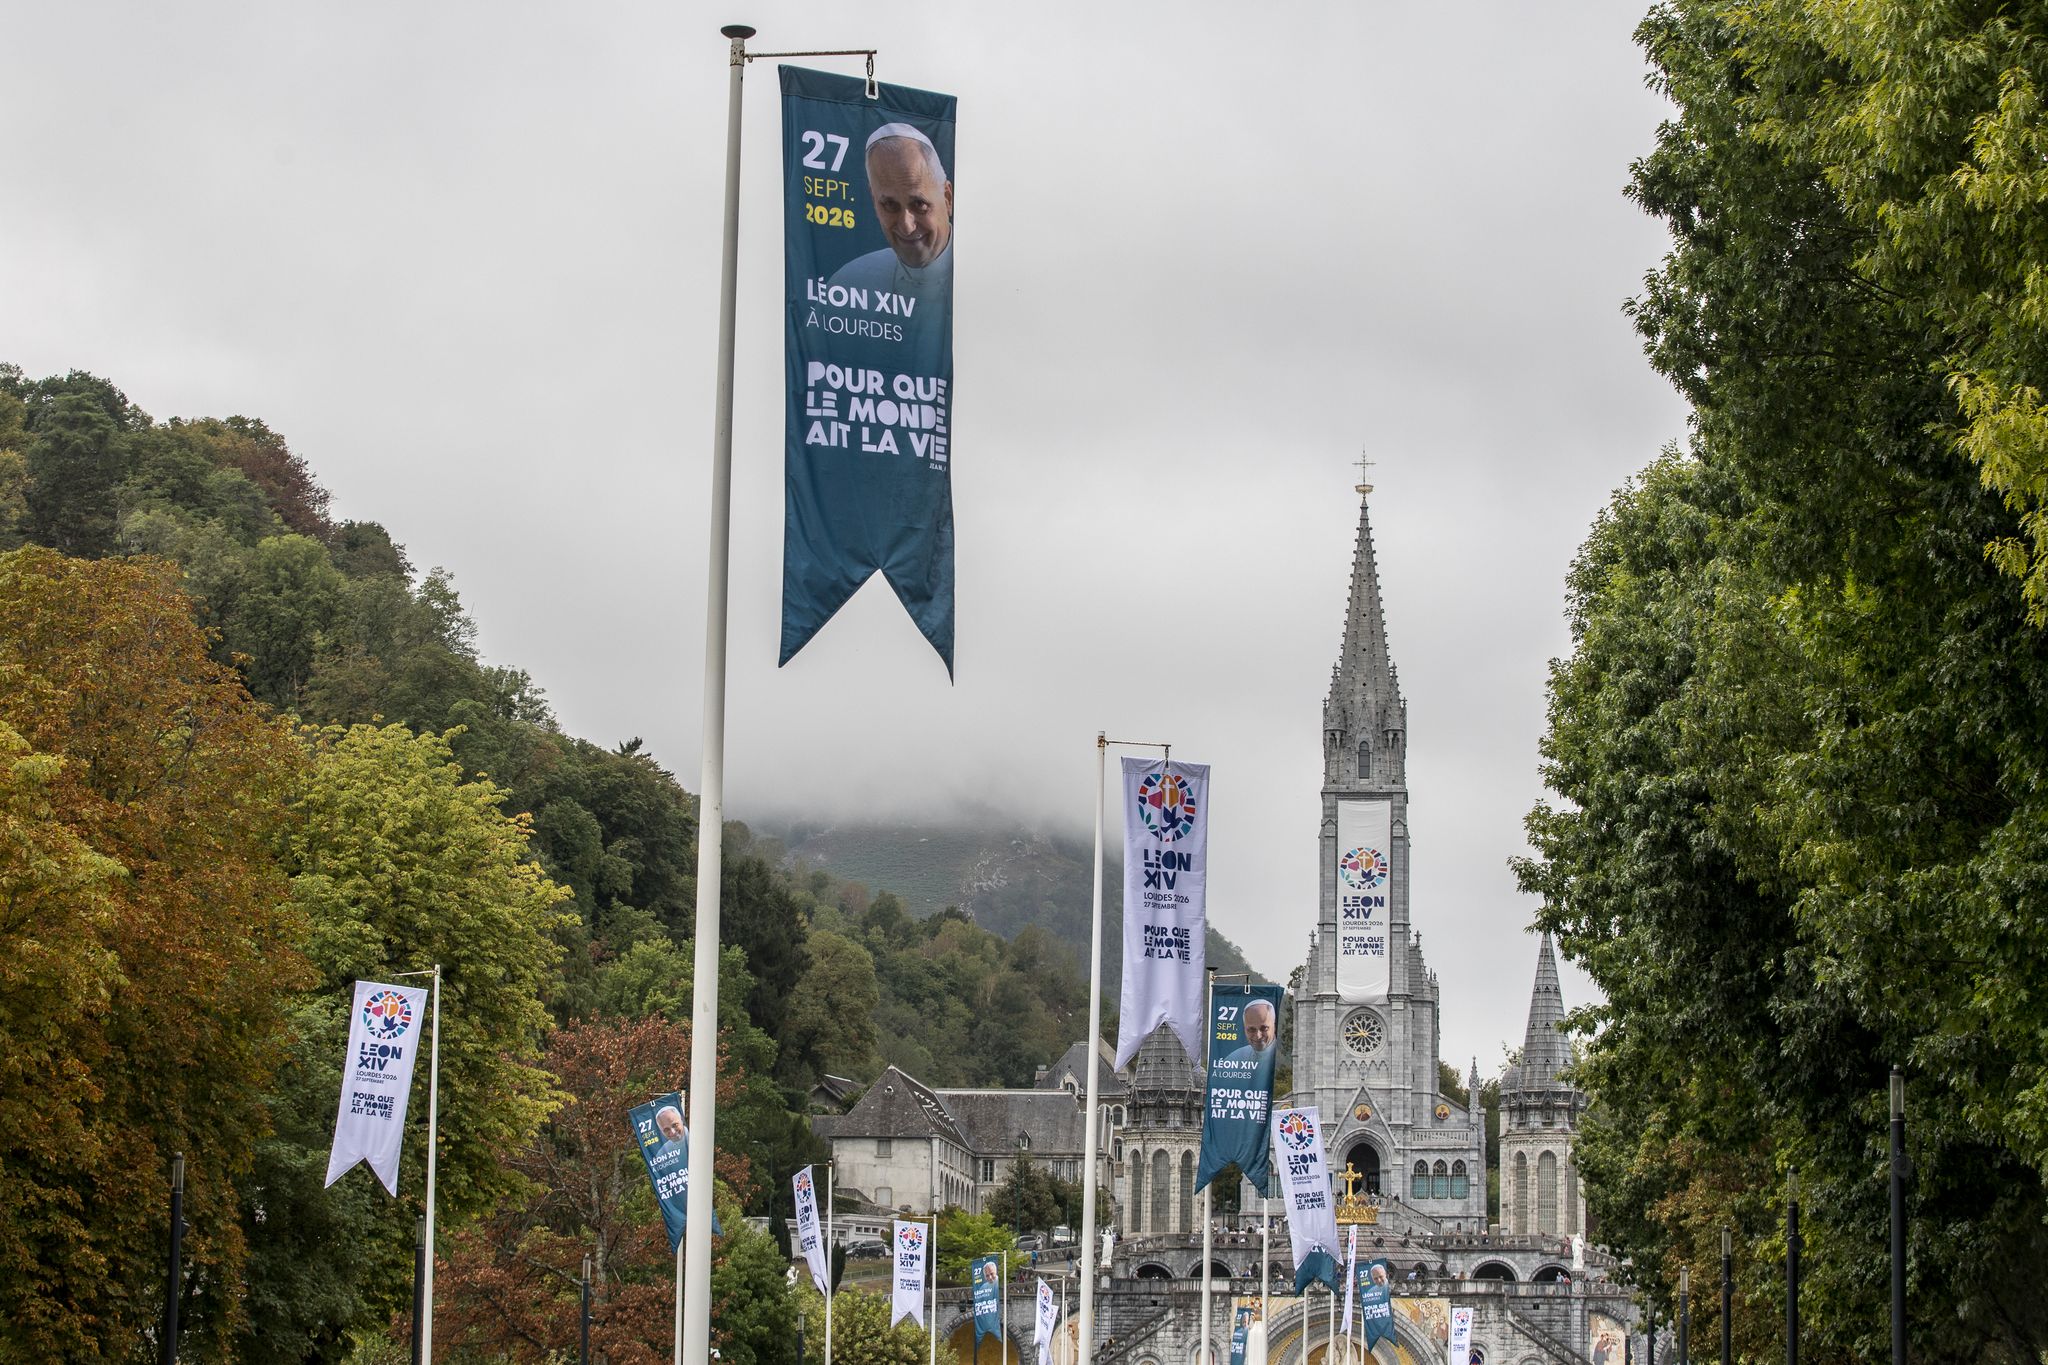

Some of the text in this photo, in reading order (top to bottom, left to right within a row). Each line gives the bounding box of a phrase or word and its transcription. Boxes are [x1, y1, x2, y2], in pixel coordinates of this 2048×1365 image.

[802, 131, 849, 172] 27
[804, 176, 854, 201] SEPT.
[806, 203, 855, 229] 2026
[808, 276, 915, 317] LÉON XIV
[806, 307, 902, 341] À LOURDES
[808, 361, 947, 405] POUR QUE
[807, 391, 946, 433] LE MONDE
[806, 421, 947, 462] AIT LA VIE
[1144, 849, 1192, 872] LEON
[1144, 869, 1176, 890] XIV
[1343, 896, 1384, 907] LEON
[1343, 908, 1372, 919] XIV
[1144, 925, 1190, 938] POUR QUE
[1145, 936, 1190, 949] LE MONDE
[1158, 949, 1174, 958] LA
[1177, 950, 1190, 960] VIE
[1218, 1006, 1238, 1020] 27
[1217, 1022, 1238, 1031] SEPT.
[1216, 1032, 1237, 1040] 2026
[360, 1042, 402, 1059] LEON
[358, 1056, 388, 1071] XIV
[1213, 1058, 1258, 1070] LÉON XIV
[354, 1092, 394, 1103] POUR QUE
[1211, 1088, 1268, 1100] POUR QUE
[364, 1101, 393, 1111] MONDE
[1211, 1099, 1267, 1110] LE MONDE
[380, 1110, 392, 1118] VIE
[1211, 1109, 1266, 1120] AIT LA VIE
[639, 1119, 652, 1133] 27
[668, 1149, 681, 1159] XIV
[1287, 1153, 1318, 1164] LEON
[1290, 1165, 1310, 1175] XIV
[657, 1172, 677, 1186] POUR
[658, 1184, 668, 1194] LE
[661, 1185, 685, 1200] AIT LA
[900, 1253, 920, 1261] LEON
[1360, 1270, 1368, 1278] 27
